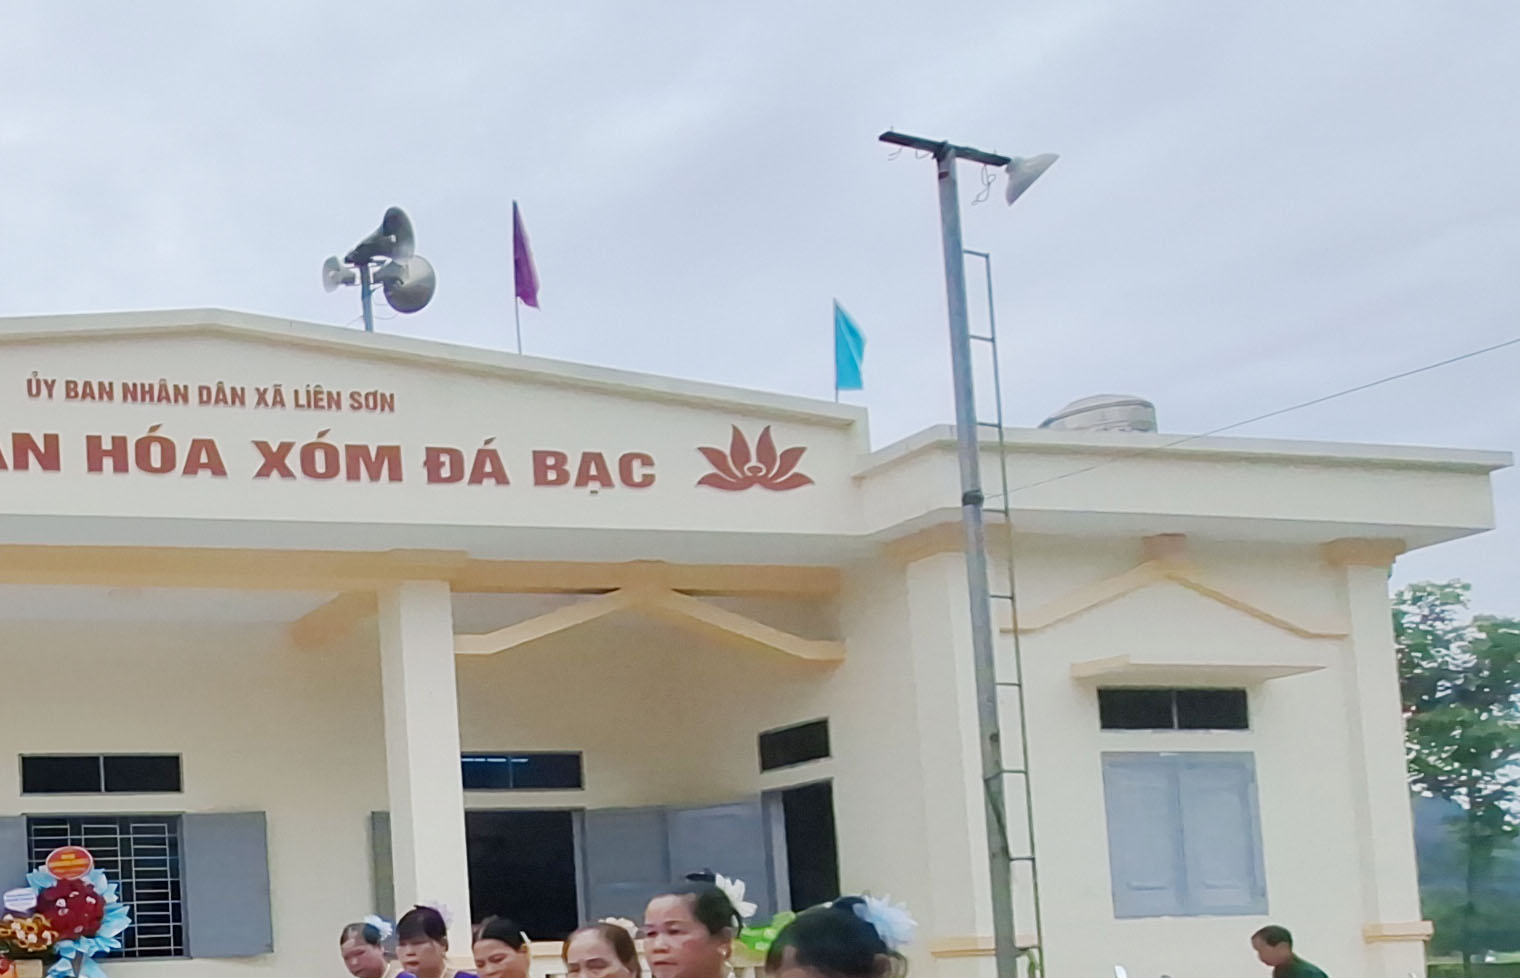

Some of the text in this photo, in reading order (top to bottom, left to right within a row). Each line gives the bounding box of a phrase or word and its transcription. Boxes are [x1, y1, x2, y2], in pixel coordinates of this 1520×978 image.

[26, 371, 57, 399] ỦY
[65, 379, 114, 402] BAN
[122, 378, 189, 404] NHÂN
[198, 381, 246, 407] DÂN
[255, 384, 286, 408] XÃ
[349, 390, 395, 412] SƠN
[86, 423, 228, 477] HÓA
[251, 428, 403, 482] XÓM
[423, 437, 511, 486] ĐÁ
[532, 450, 656, 495] BẠC
